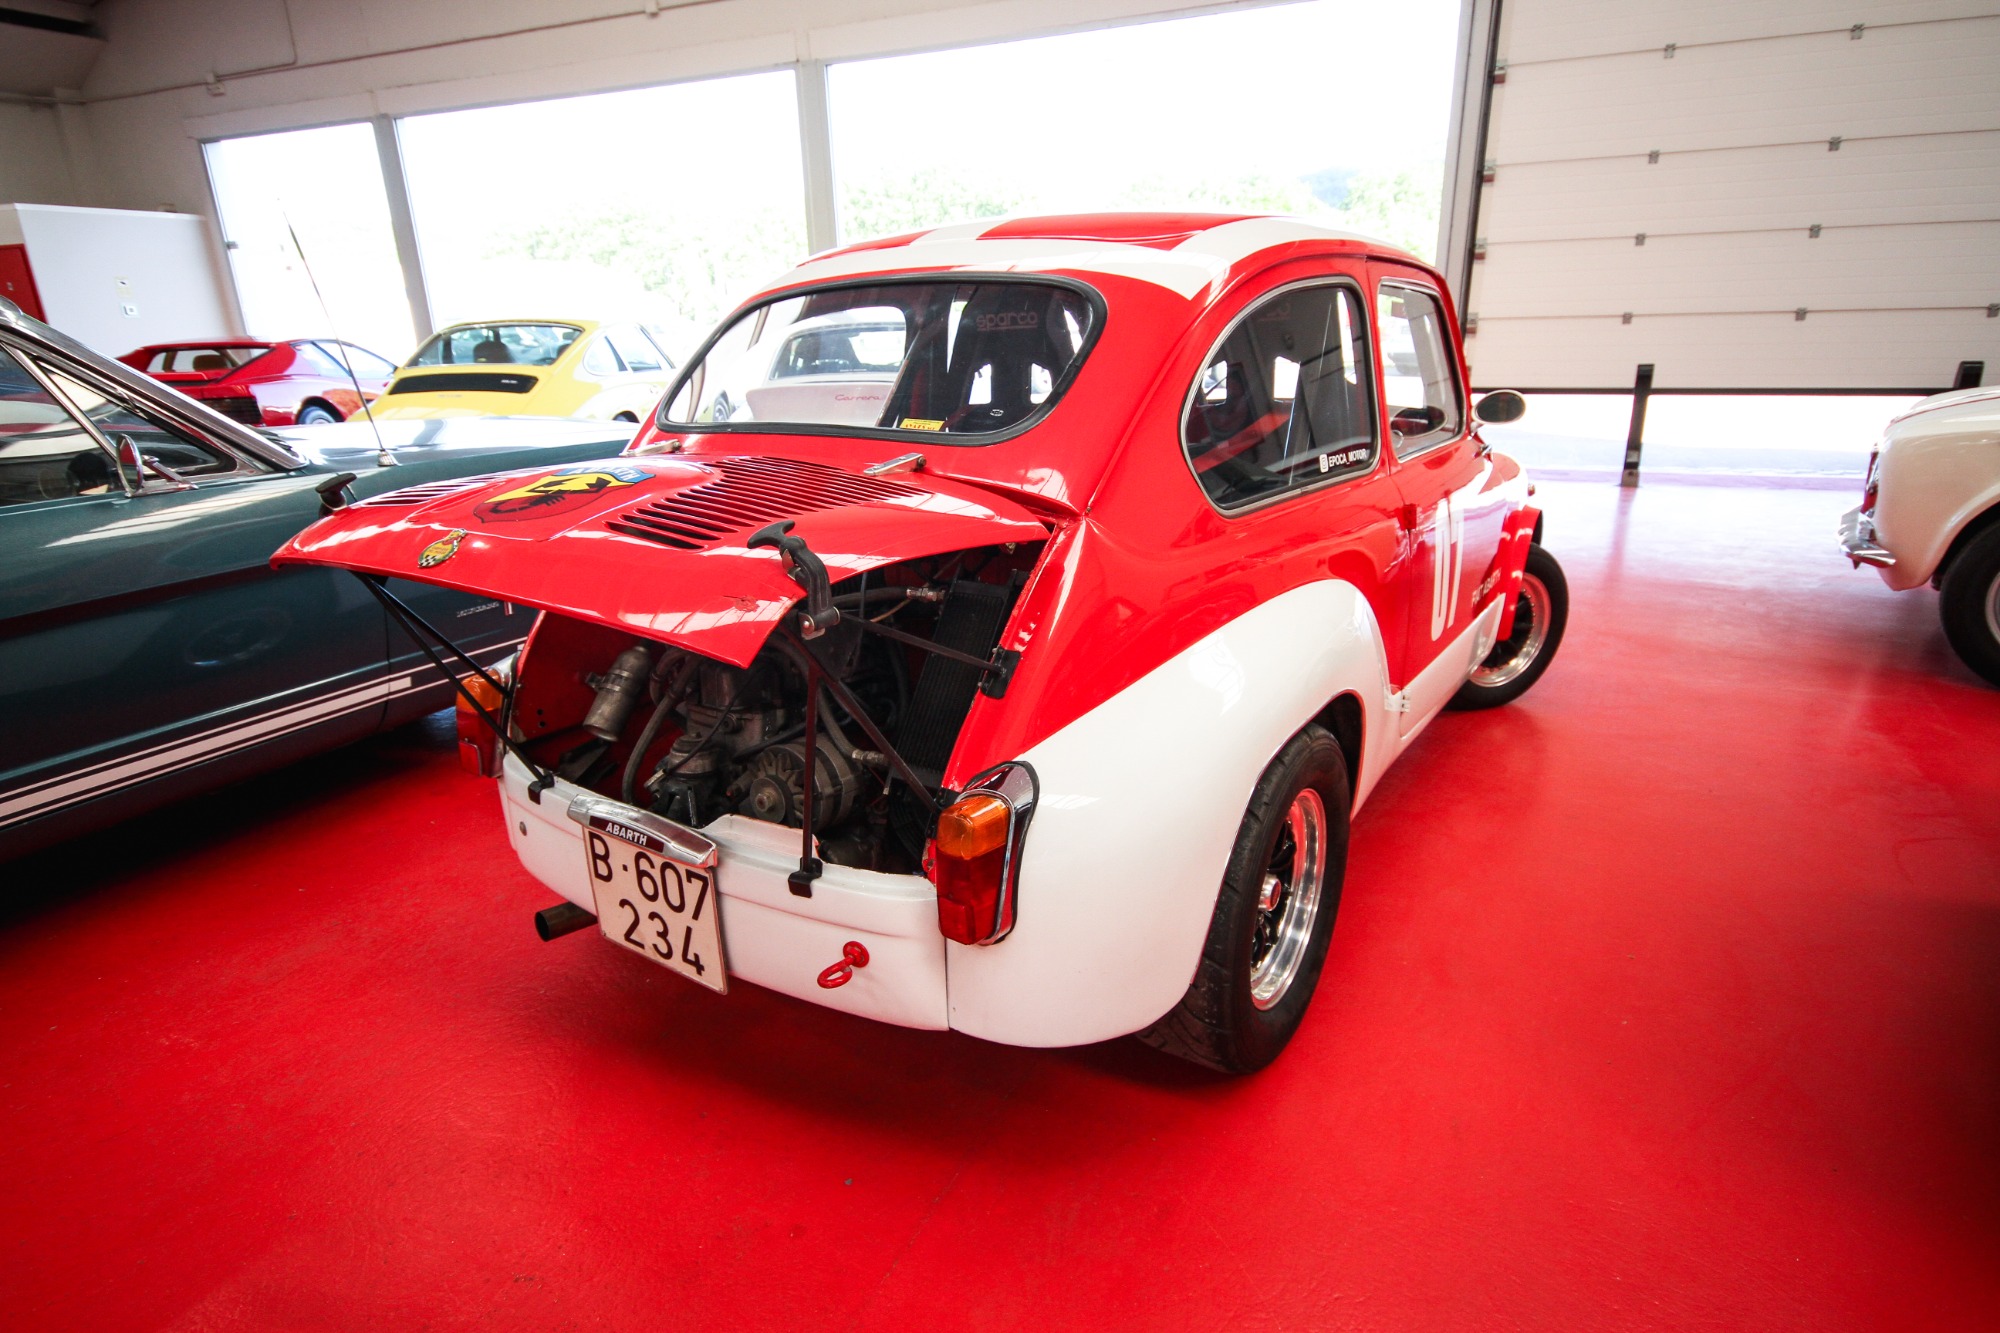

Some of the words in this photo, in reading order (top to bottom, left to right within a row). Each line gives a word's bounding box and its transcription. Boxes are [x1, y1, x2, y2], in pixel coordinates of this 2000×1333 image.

[976, 312, 1038, 332] sparco
[835, 394, 881, 402] Carrera
[605, 822, 647, 846] ABARTH
[618, 898, 706, 977] 234
